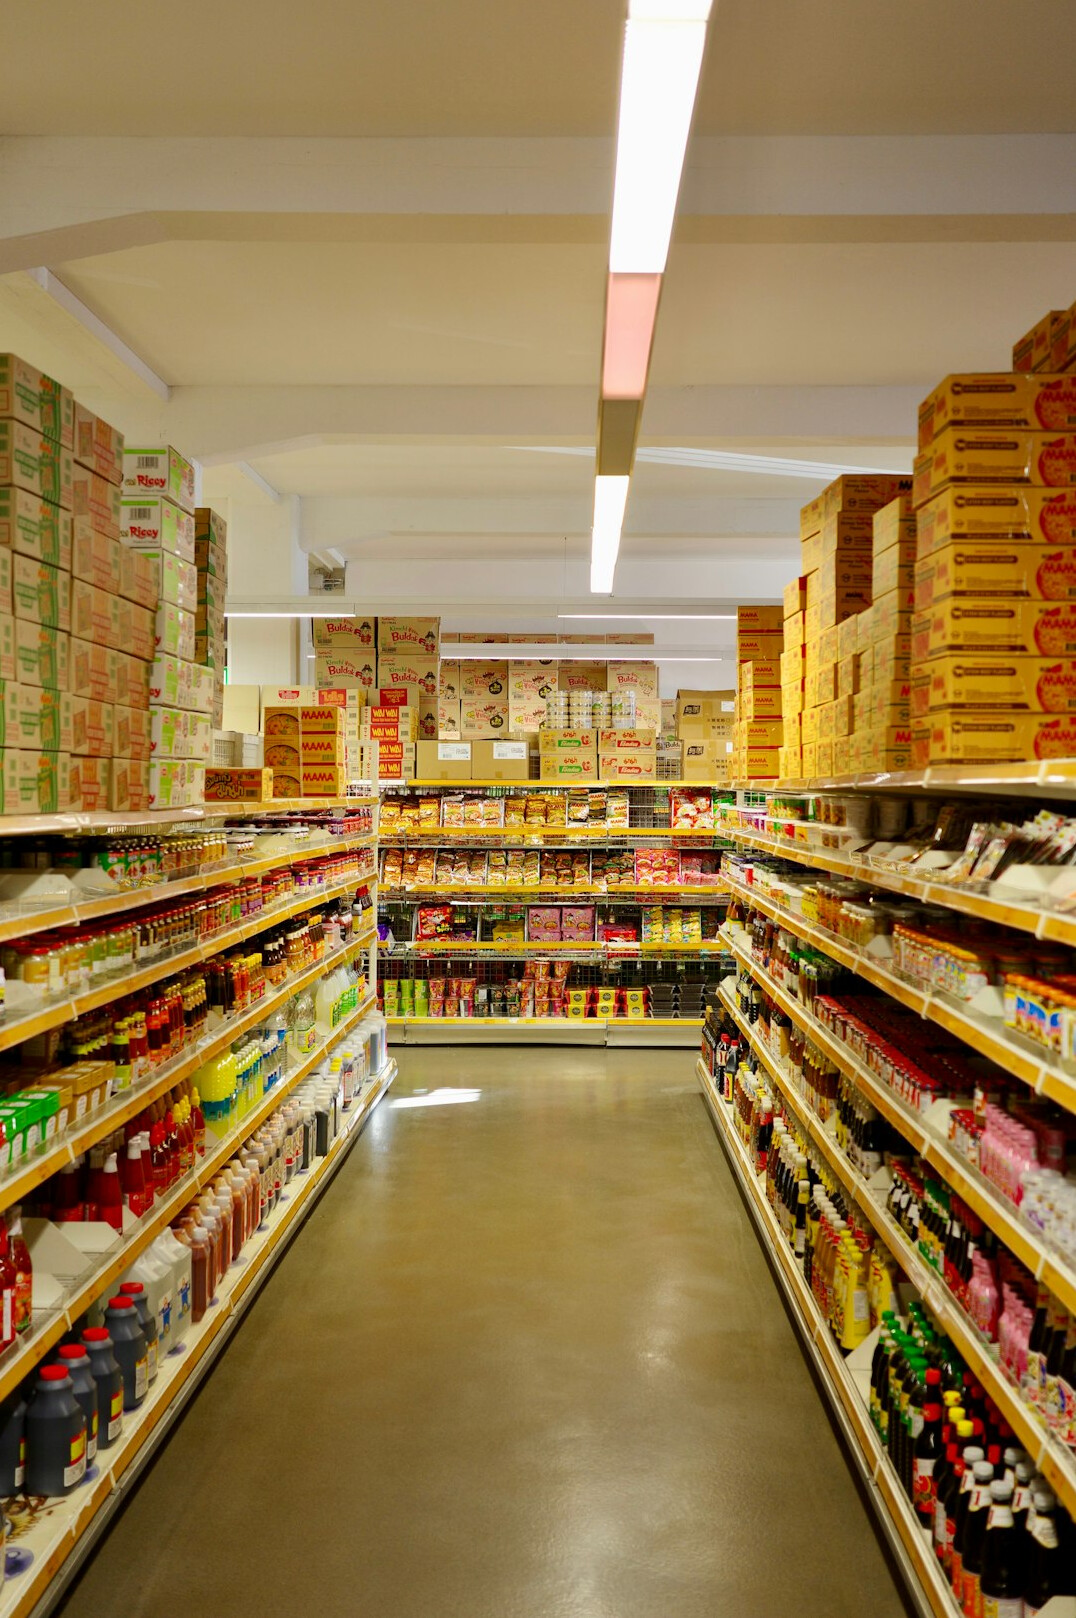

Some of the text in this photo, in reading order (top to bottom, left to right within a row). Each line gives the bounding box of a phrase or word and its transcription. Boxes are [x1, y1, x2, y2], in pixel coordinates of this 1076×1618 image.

[301, 710, 333, 719] MAMA
[301, 742, 332, 751] MAMA
[302, 772, 334, 781] MAMA
